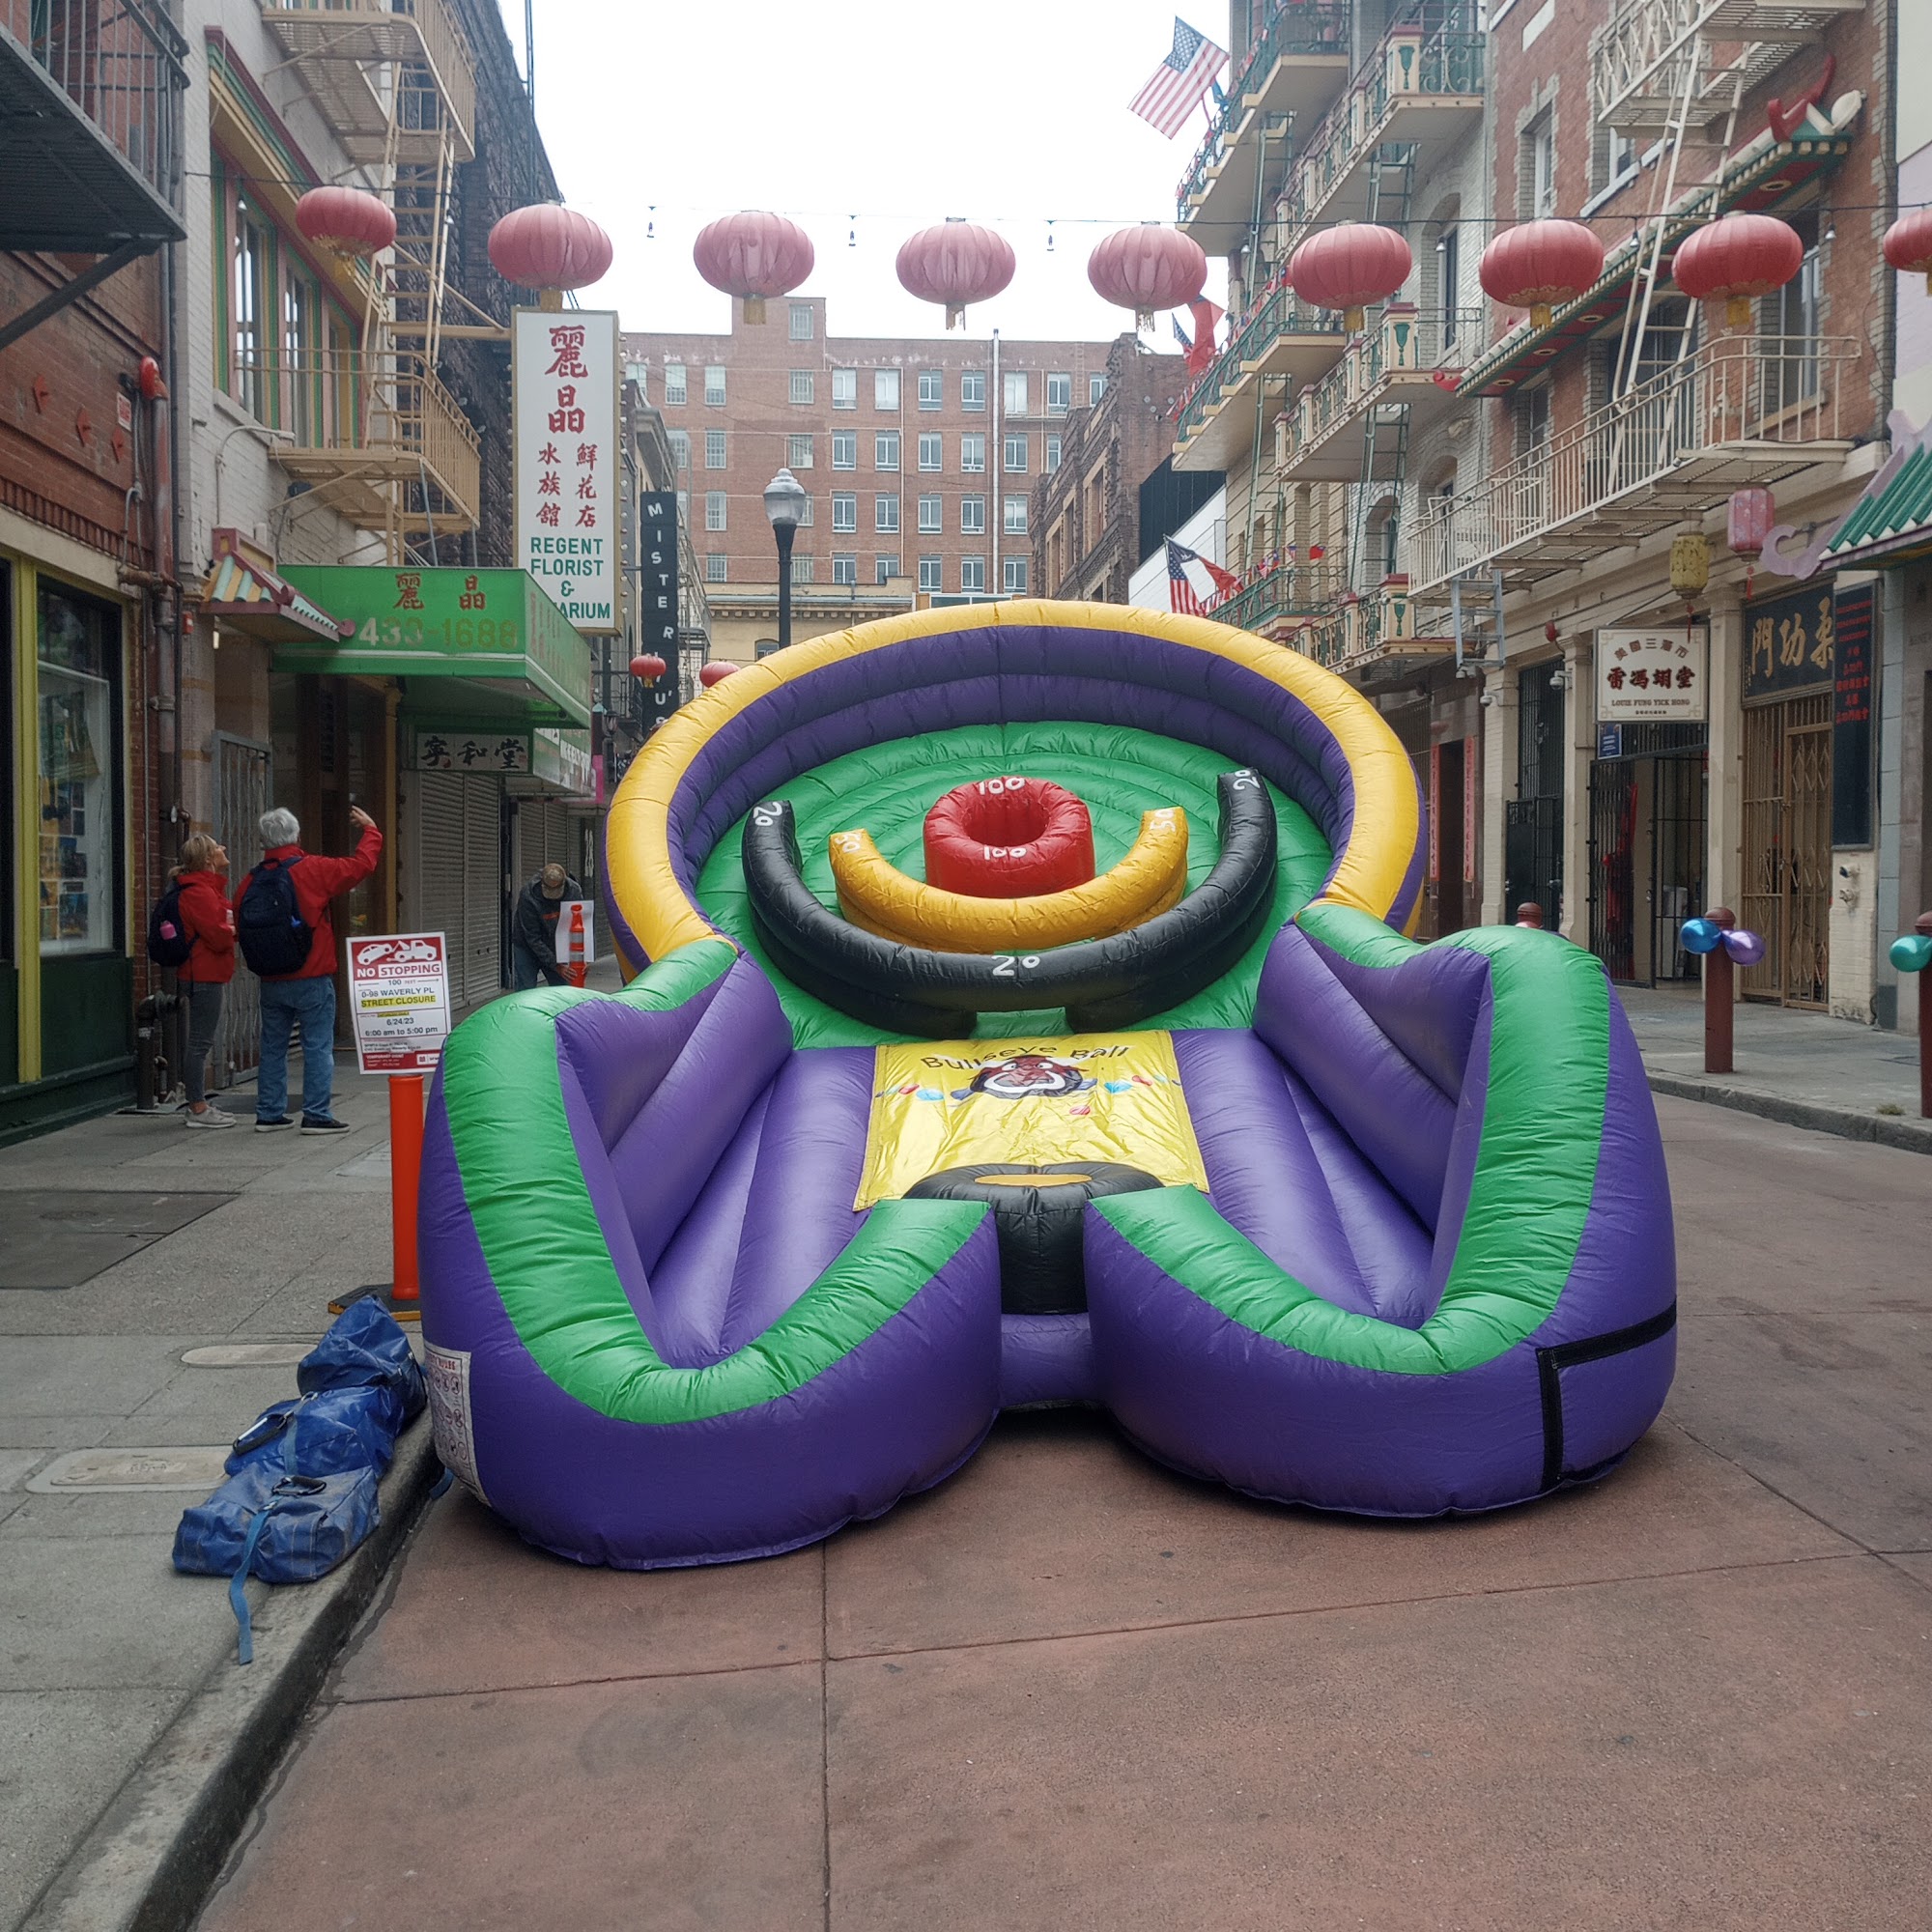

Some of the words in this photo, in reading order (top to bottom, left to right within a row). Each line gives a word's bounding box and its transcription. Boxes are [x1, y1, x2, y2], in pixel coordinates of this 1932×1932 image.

[545, 325, 588, 434] 麗晶
[575, 442, 598, 528] 鮮花店
[530, 537, 604, 554] REGENT
[530, 558, 604, 576] FLORIST
[647, 502, 673, 639] MISTER
[560, 580, 575, 596] &
[554, 602, 611, 618] ARIUM
[358, 617, 518, 648] 433-1688
[979, 776, 1026, 795] 100
[982, 846, 1027, 860] 100
[357, 968, 376, 978] NO
[381, 964, 440, 976] STOPPING
[991, 954, 1040, 977] 20
[381, 987, 421, 996] WAVERLY
[361, 998, 394, 1008] STREET
[395, 995, 436, 1005] CLOSURE
[921, 1046, 1058, 1070] Bullseye
[1069, 1045, 1129, 1060] Ball
